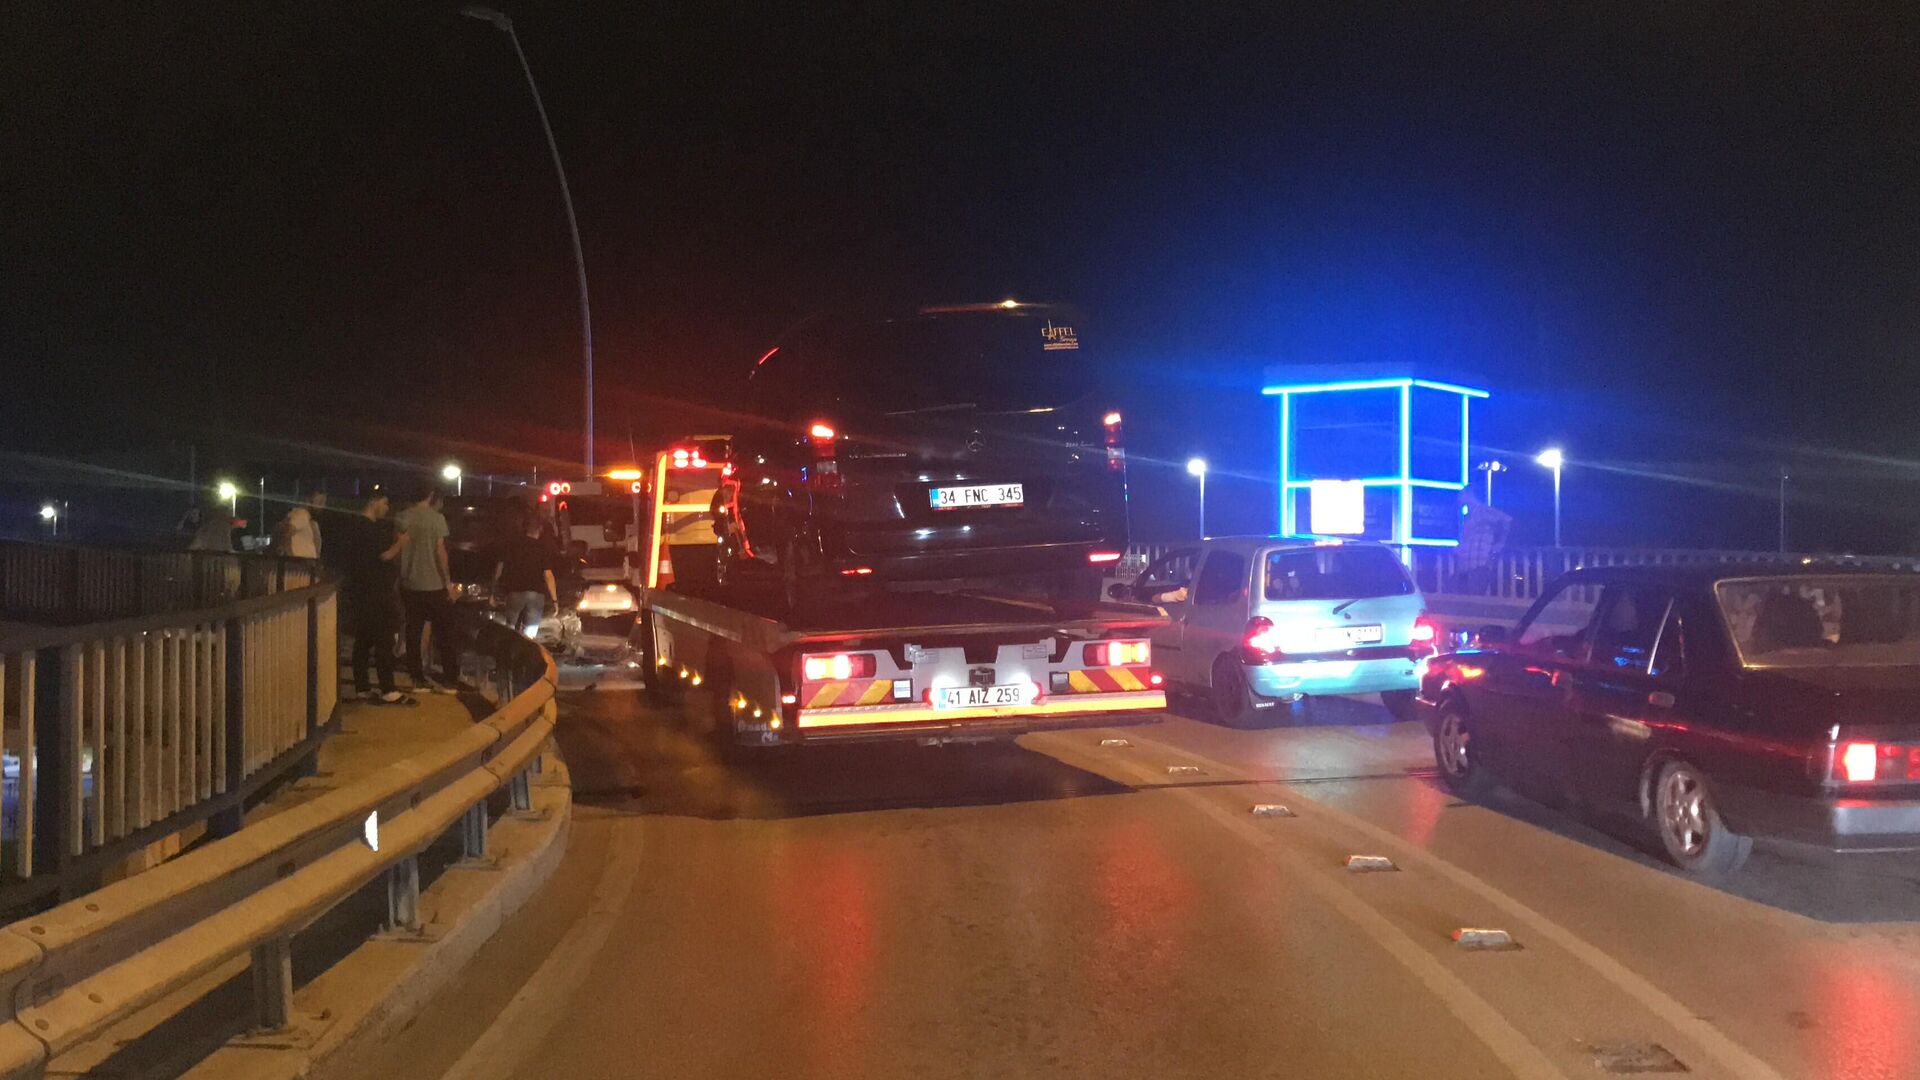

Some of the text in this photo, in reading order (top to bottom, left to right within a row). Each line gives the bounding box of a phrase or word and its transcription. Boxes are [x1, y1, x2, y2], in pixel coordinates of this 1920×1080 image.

[940, 486, 1021, 504] 34 FNC 345
[947, 687, 1020, 705] 41 AIZ 259
